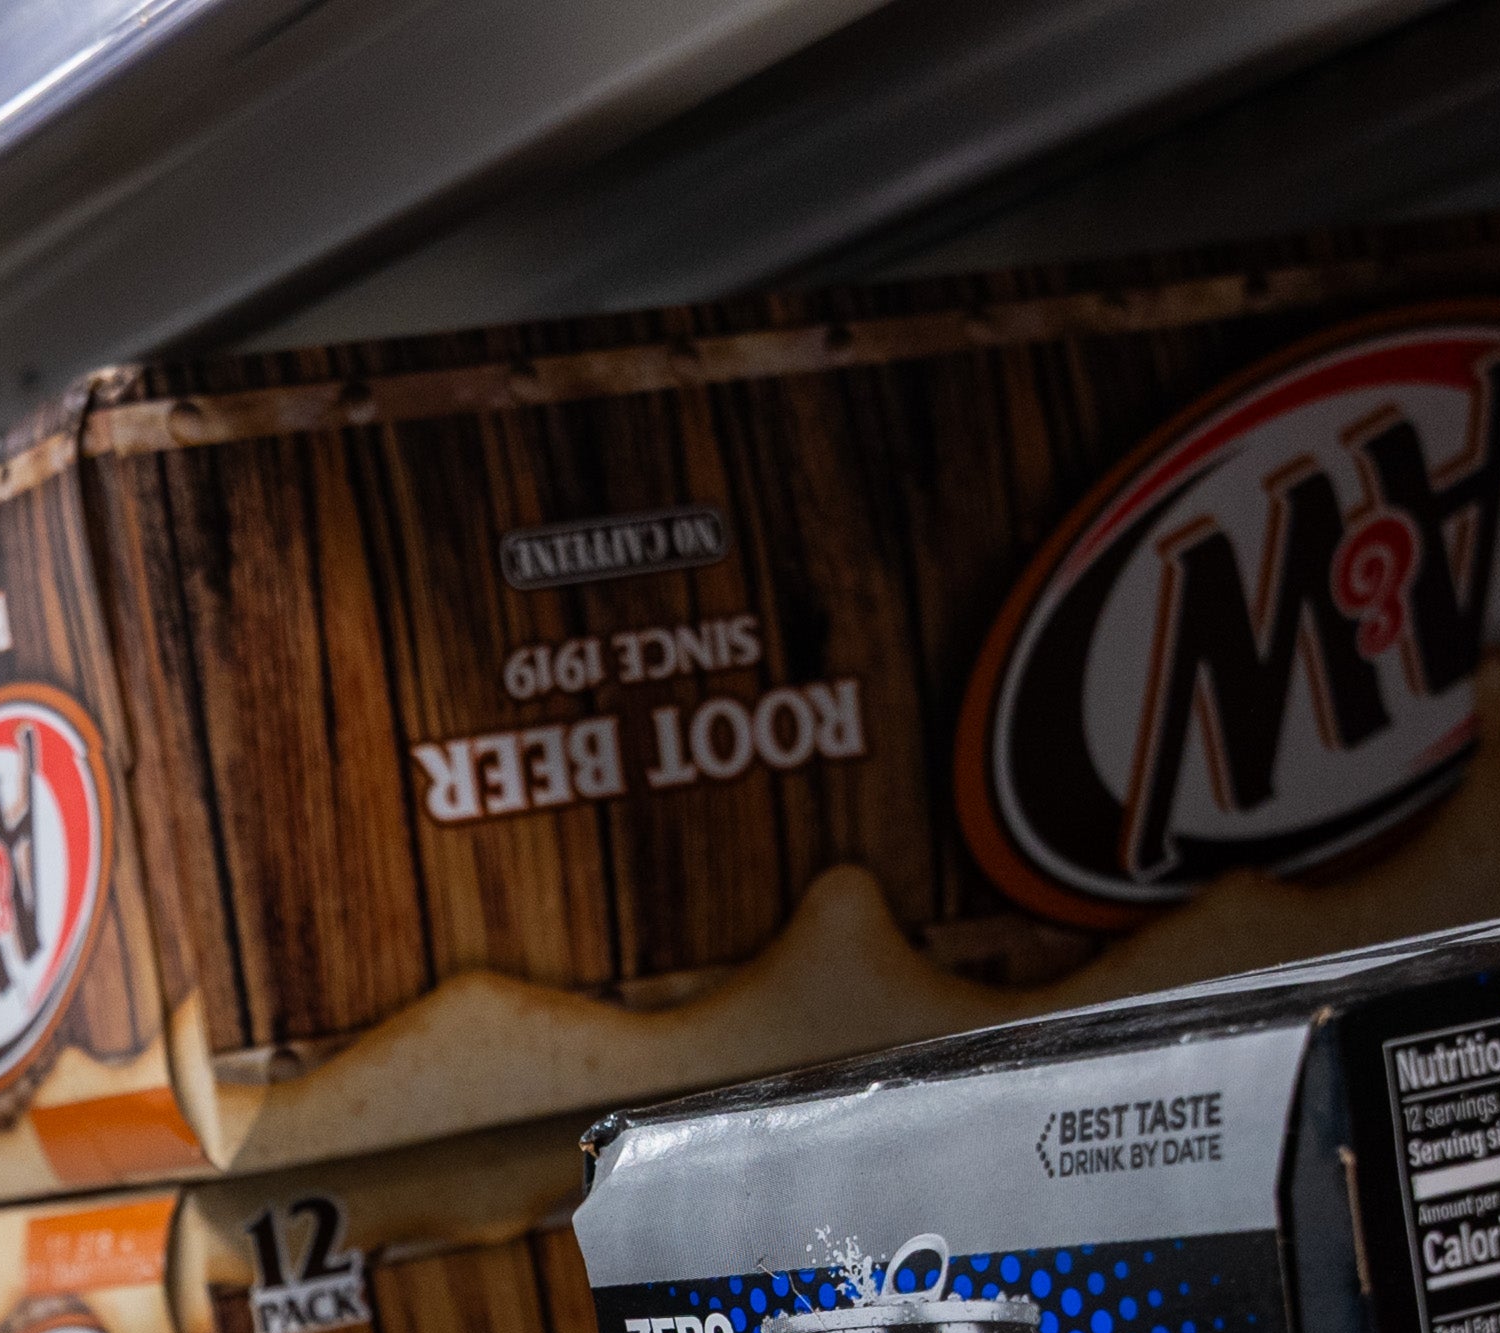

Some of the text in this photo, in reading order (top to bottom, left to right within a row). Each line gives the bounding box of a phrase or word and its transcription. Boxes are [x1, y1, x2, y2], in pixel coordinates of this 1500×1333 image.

[503, 614, 761, 702] SINCE 1919
[410, 678, 865, 825] ROOT BEER
[1058, 1133, 1223, 1178] DRINK BY DATE
[1060, 1092, 1223, 1145] BEST TASTE
[245, 1196, 354, 1288] 12
